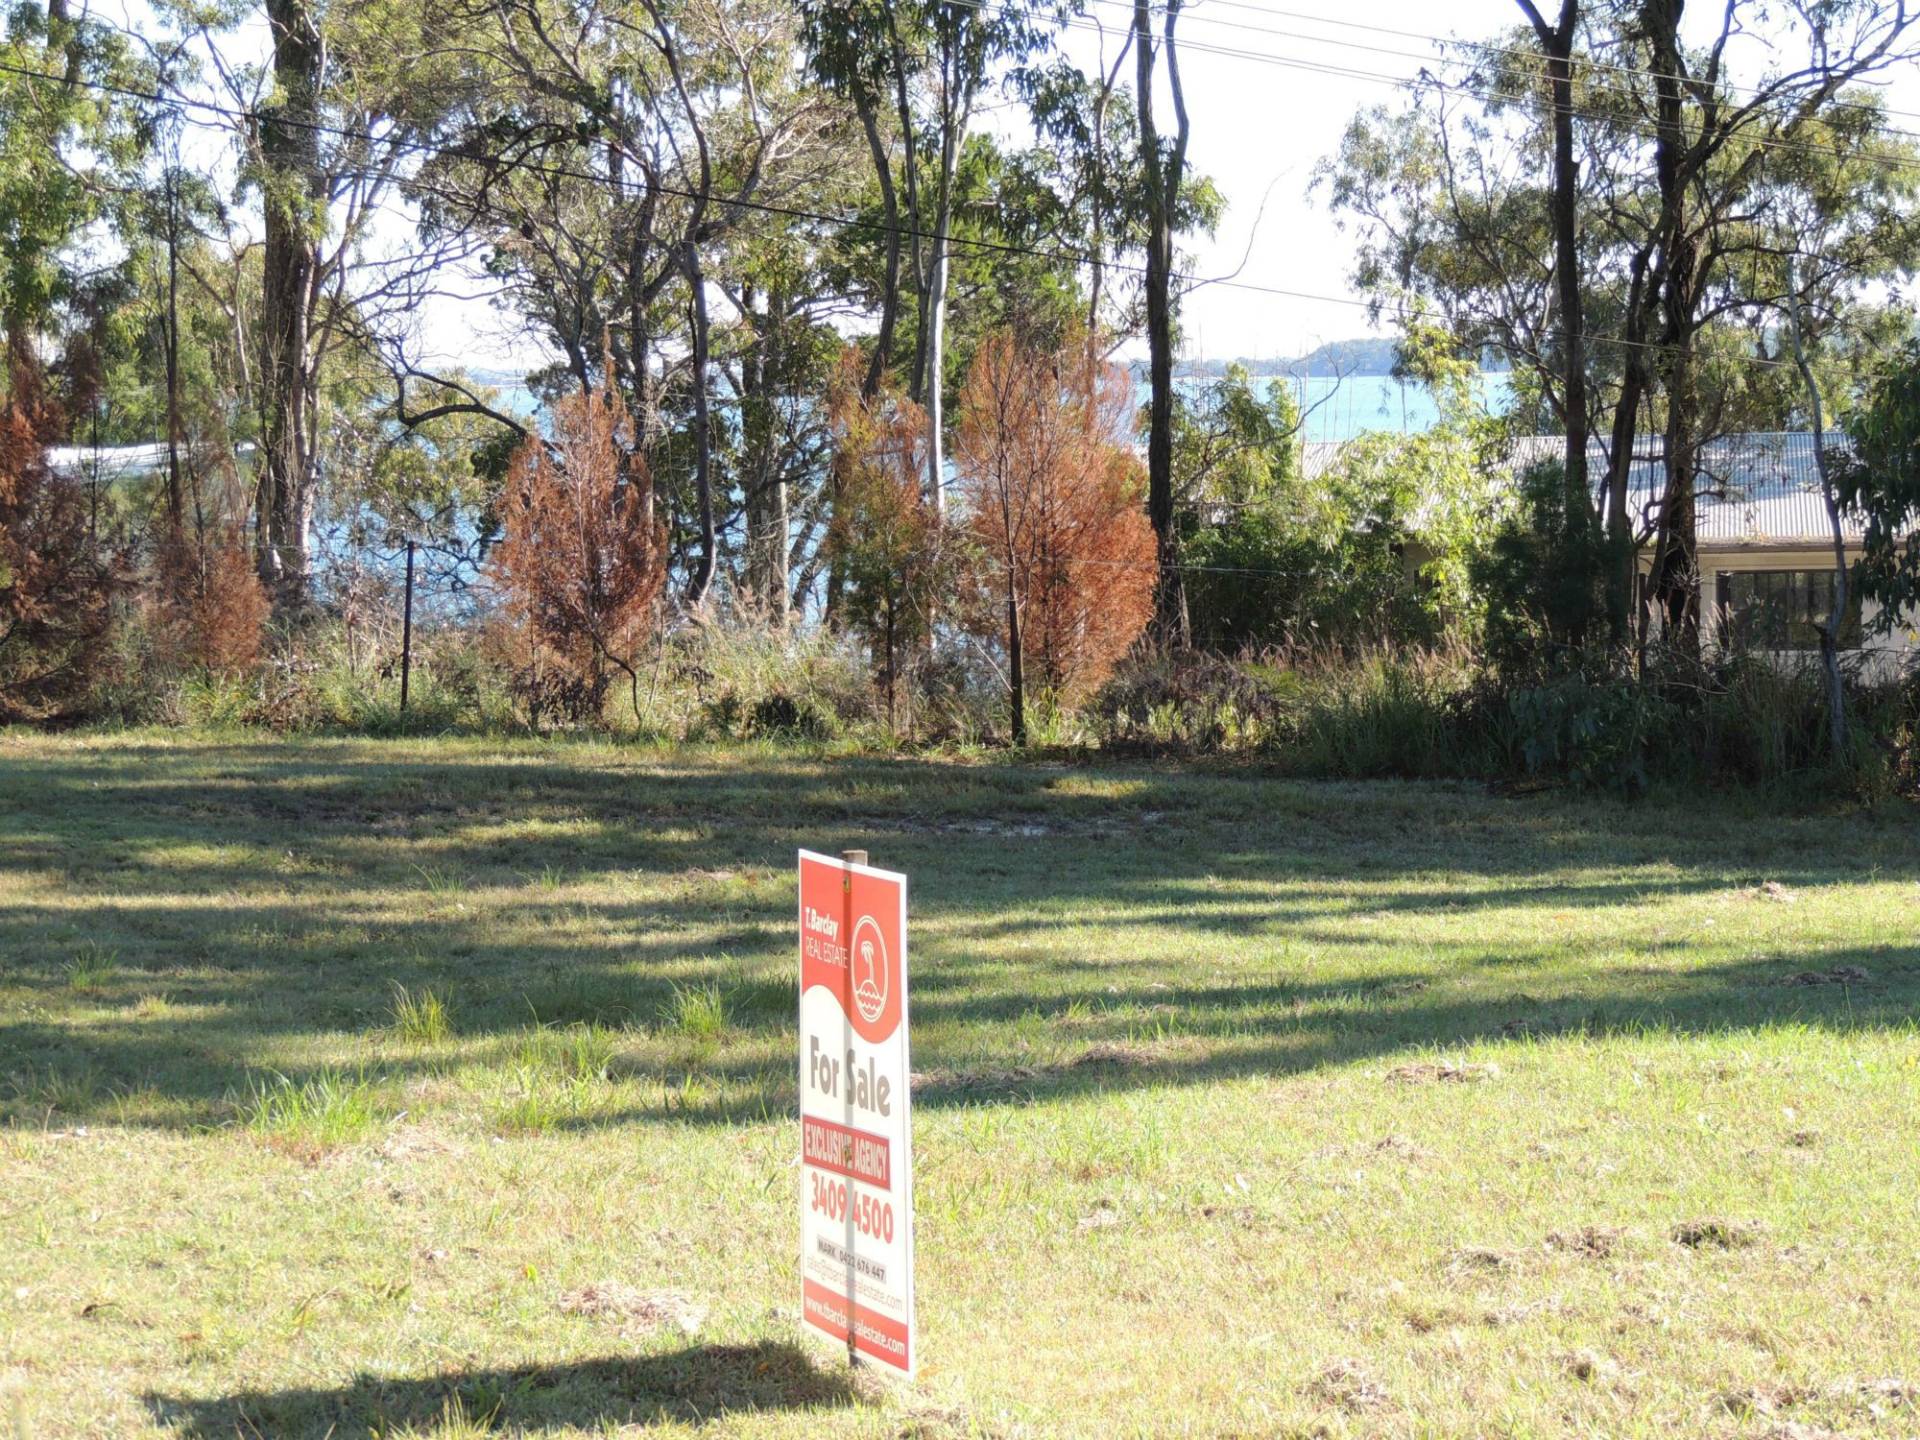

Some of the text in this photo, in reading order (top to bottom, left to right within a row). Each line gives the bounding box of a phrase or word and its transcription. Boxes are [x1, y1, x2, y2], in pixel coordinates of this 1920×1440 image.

[806, 936, 849, 968] REAL ESTATE
[810, 1035, 890, 1117] For Sale
[805, 1123, 887, 1180] EXCLUSIVE AGENCY
[812, 1171, 894, 1245] 3409 4500
[818, 1239, 837, 1259] MARK
[872, 1265, 886, 1281] 447
